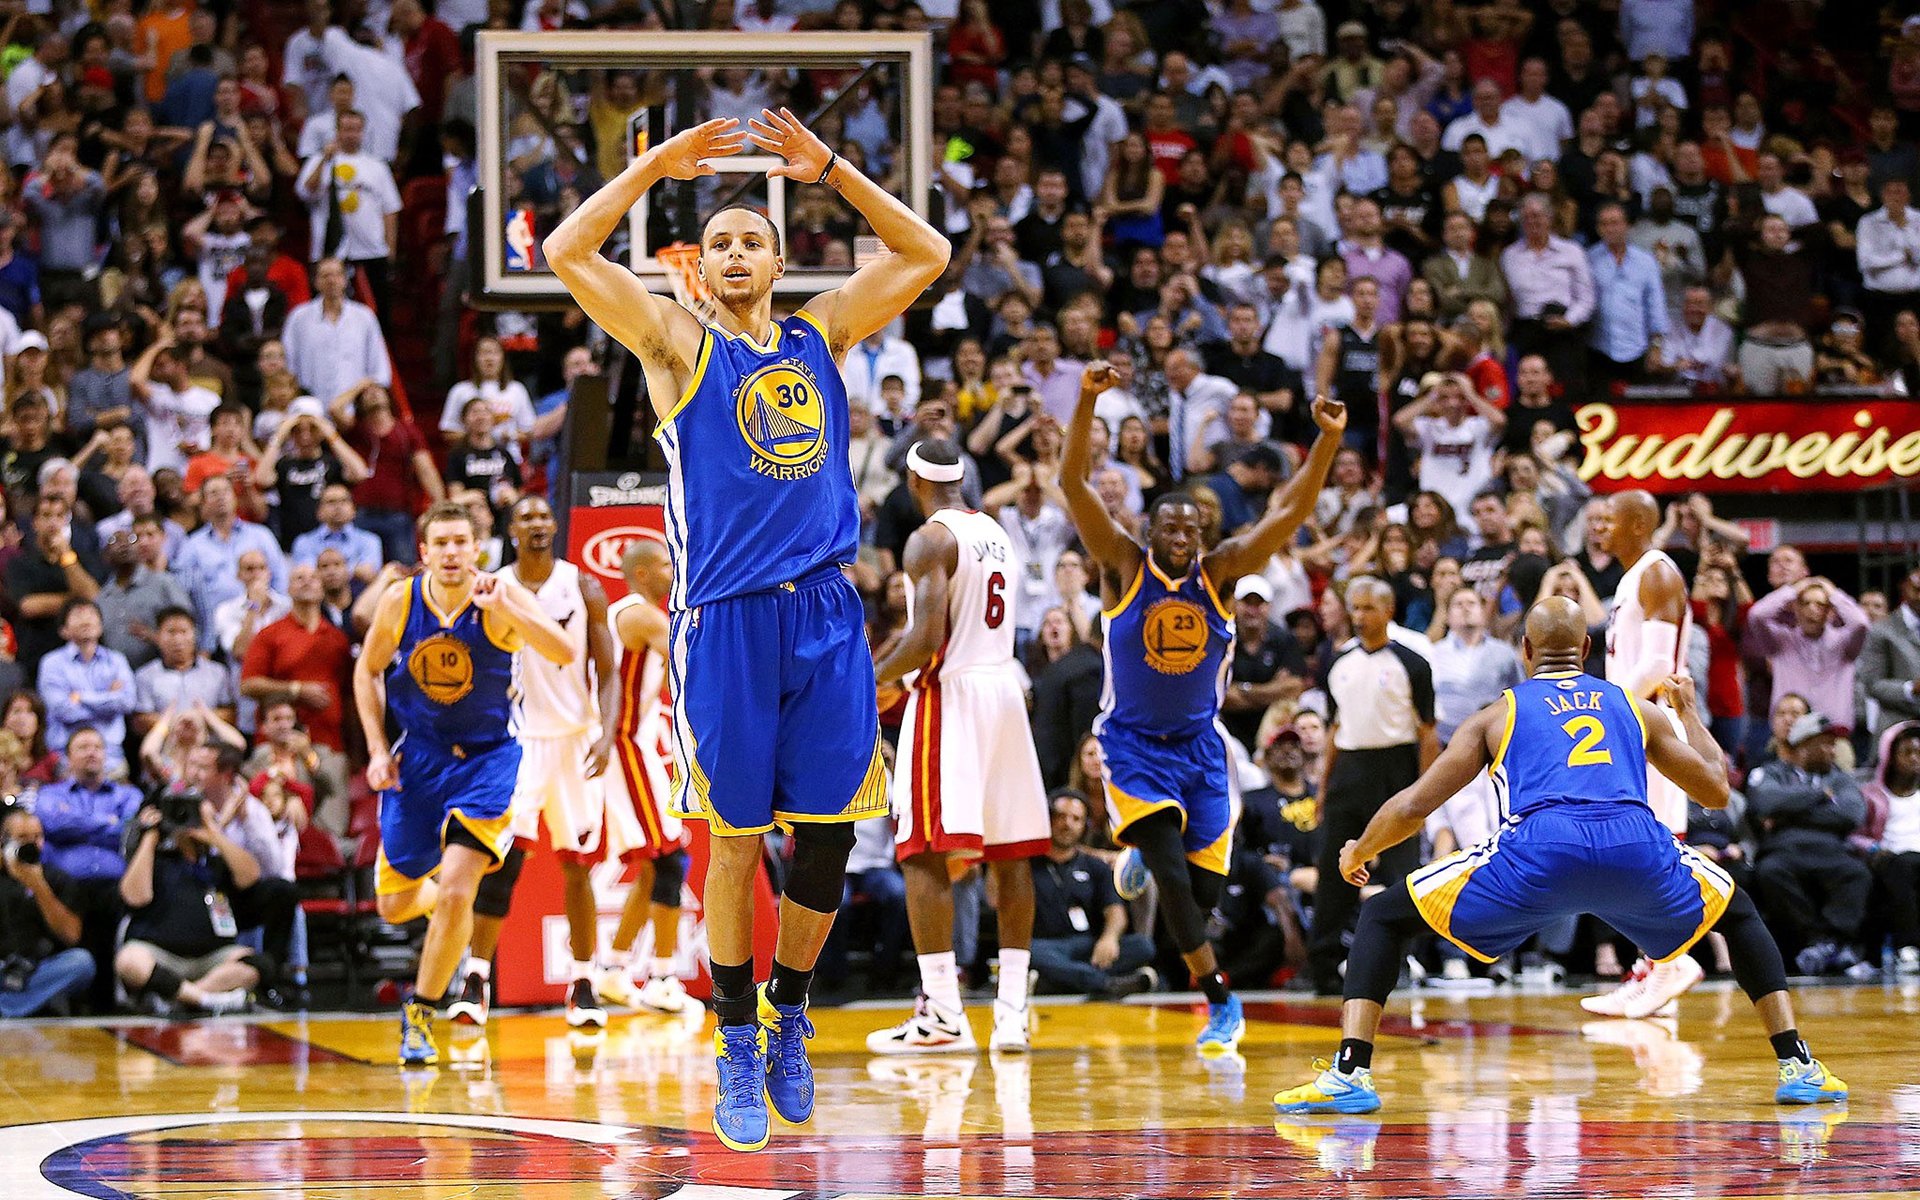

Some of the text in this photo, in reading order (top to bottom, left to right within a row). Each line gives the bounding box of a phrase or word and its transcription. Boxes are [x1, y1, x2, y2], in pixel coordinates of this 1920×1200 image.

[776, 382, 808, 408] 30
[984, 572, 1006, 629] 6
[1173, 614, 1195, 630] 23
[441, 652, 458, 668] 10
[1543, 691, 1604, 716] JACK
[1560, 714, 1614, 768] 2
